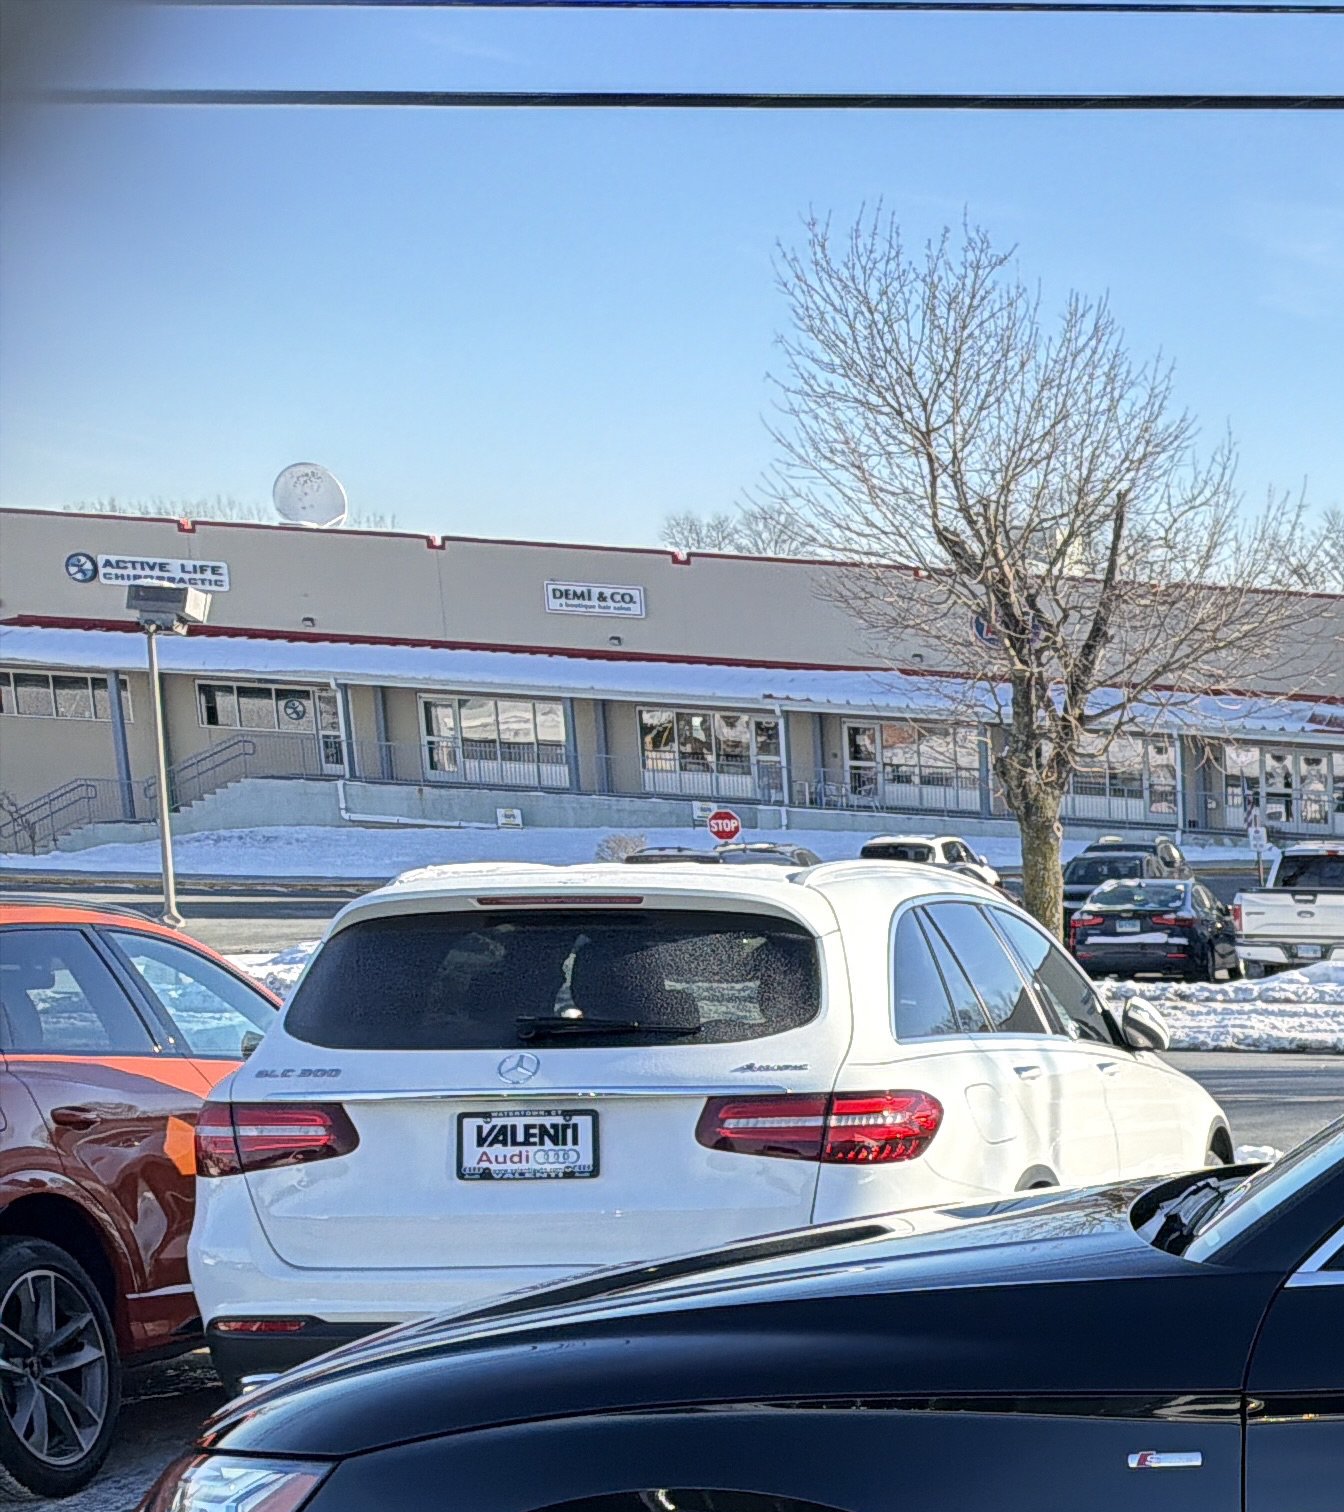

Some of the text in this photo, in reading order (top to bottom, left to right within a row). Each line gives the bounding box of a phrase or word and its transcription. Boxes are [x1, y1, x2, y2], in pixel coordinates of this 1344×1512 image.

[102, 558, 224, 577] ACTIVE LIFE
[596, 591, 608, 603] &
[710, 819, 739, 832] STOP
[475, 1122, 579, 1148] VALENTI
[476, 1149, 531, 1165] Audi
